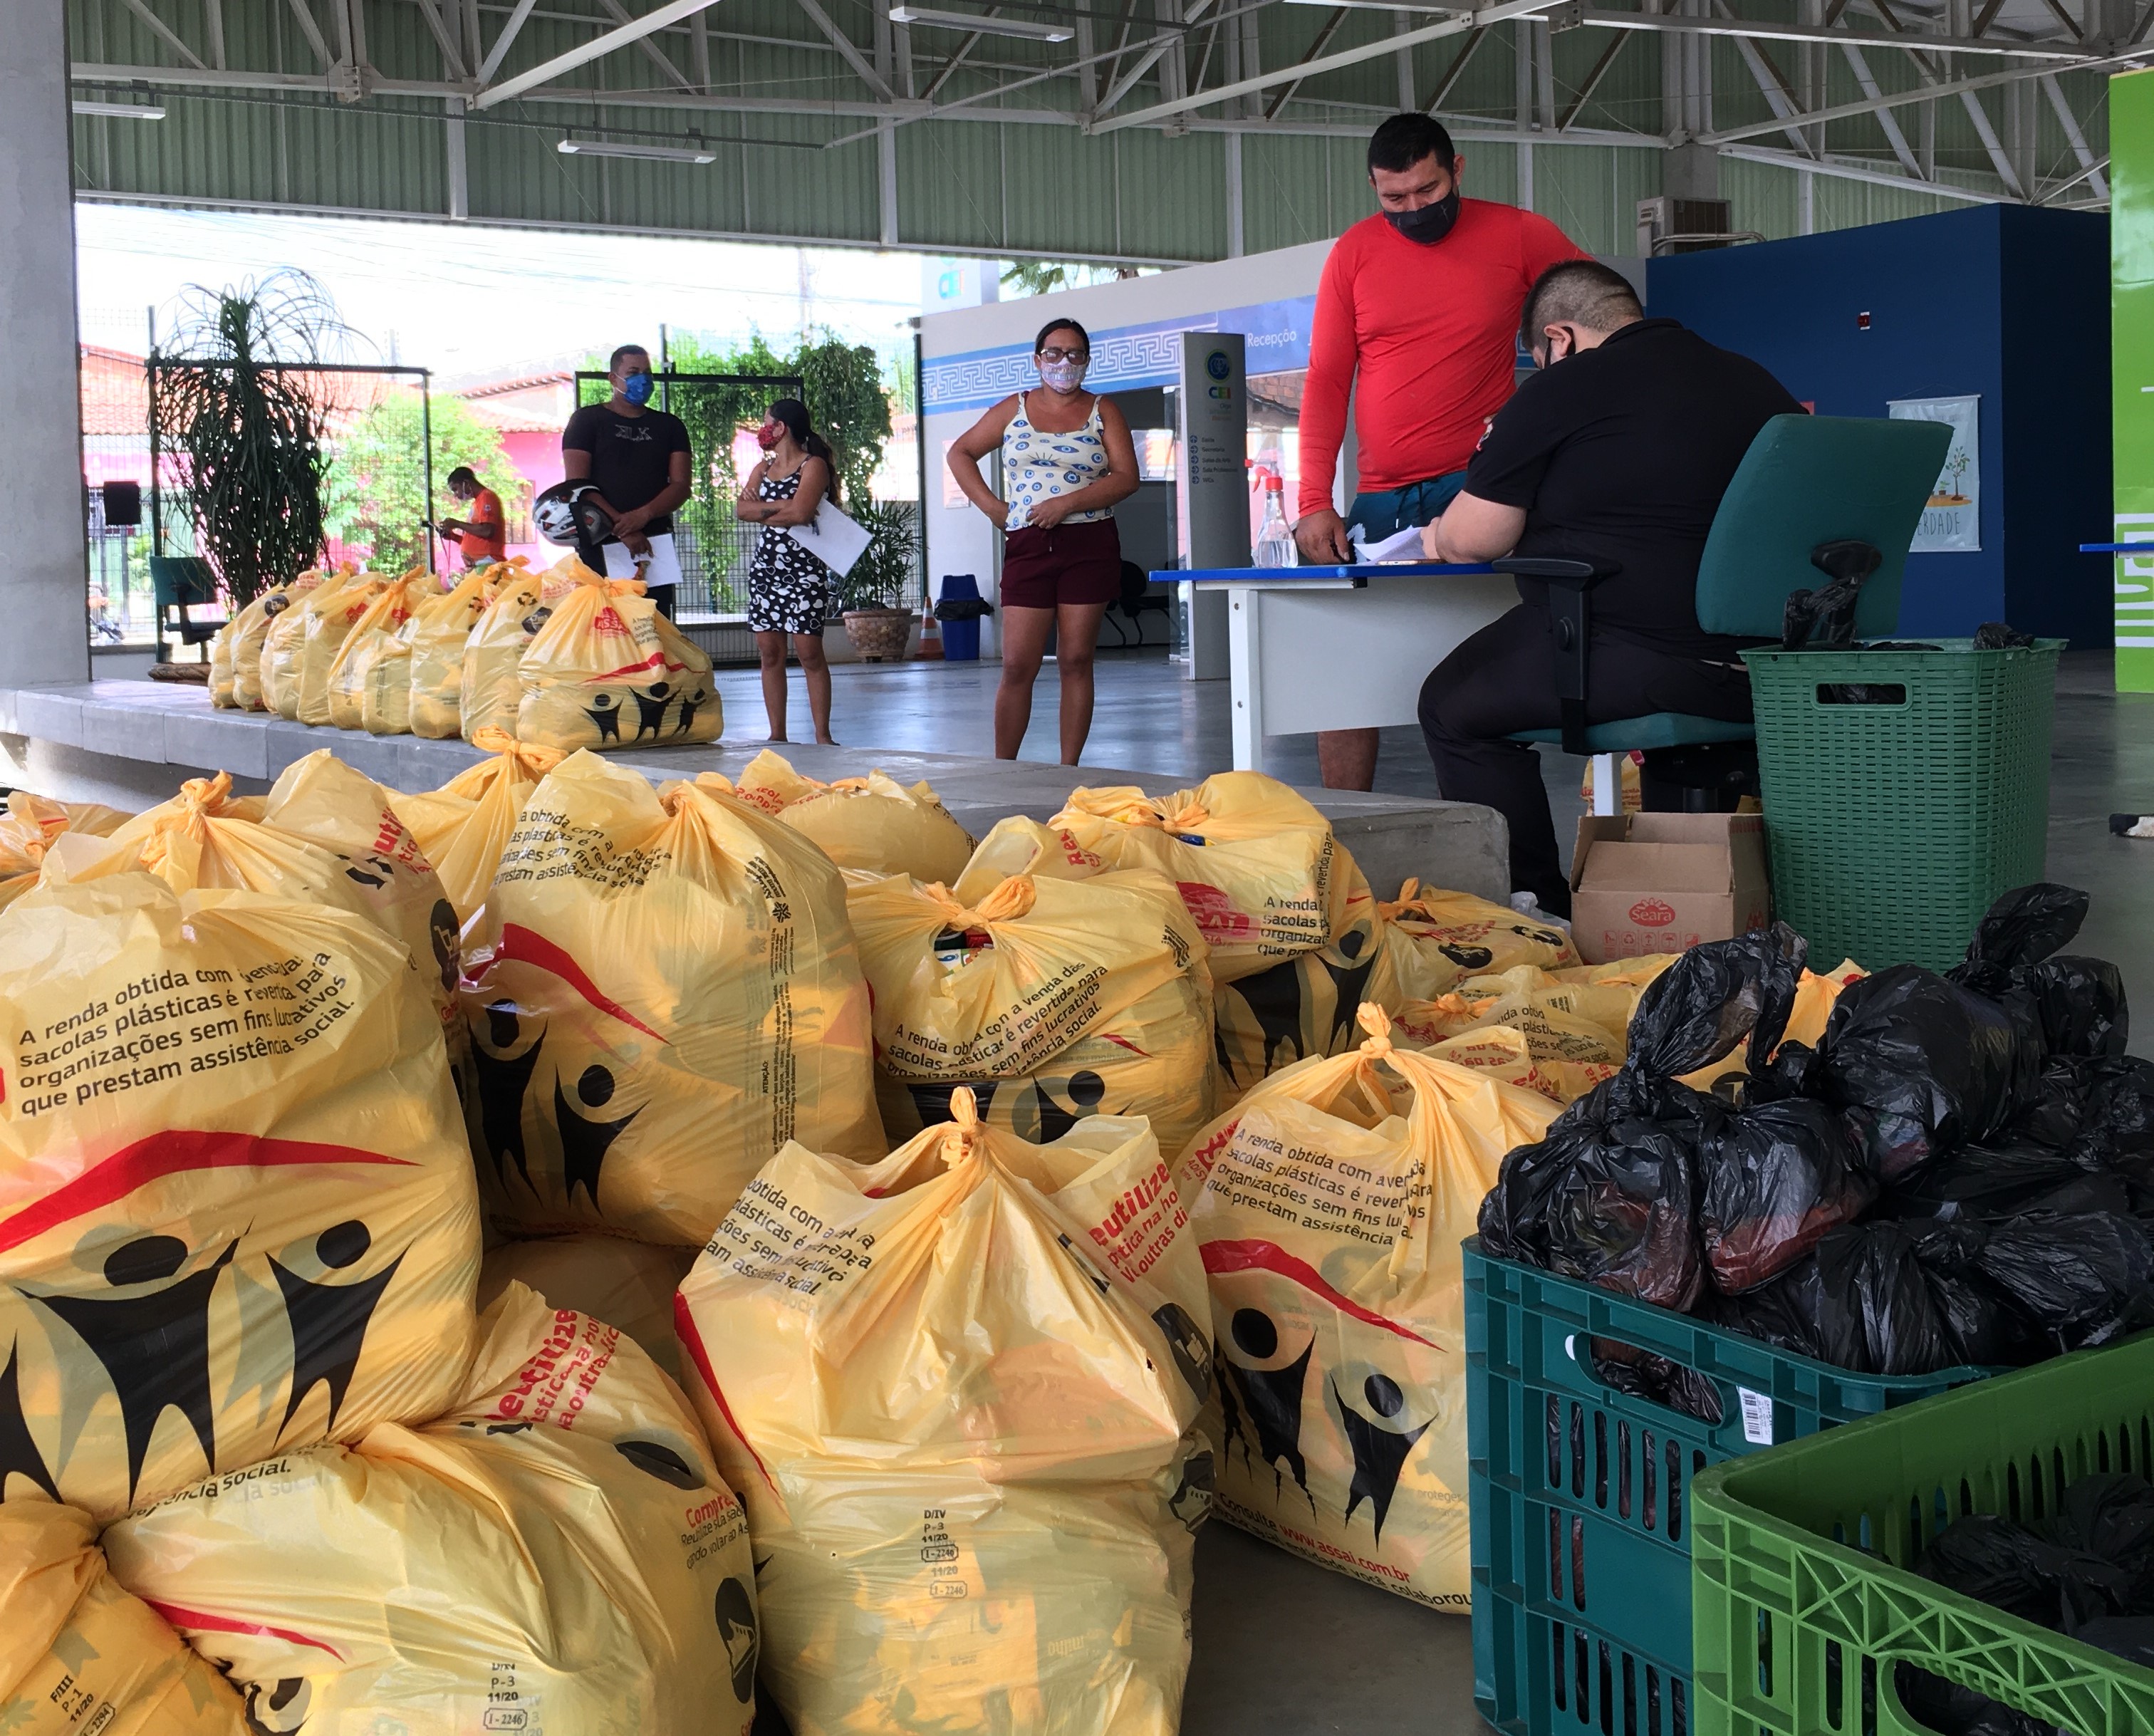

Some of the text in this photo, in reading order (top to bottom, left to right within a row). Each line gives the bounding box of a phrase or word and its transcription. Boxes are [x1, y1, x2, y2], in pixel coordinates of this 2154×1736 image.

[1263, 914, 1316, 928] sacolas
[1631, 910, 1672, 922] Seara
[19, 1030, 36, 1045] A
[46, 1002, 108, 1039] renda
[115, 970, 189, 1006] obtida
[196, 969, 233, 983] com
[20, 1024, 108, 1067] sacolas
[115, 994, 222, 1036] plásticas
[226, 989, 239, 1007] é
[296, 952, 331, 994] para
[895, 1024, 903, 1038] A
[907, 1031, 947, 1054] renda
[1011, 1004, 1023, 1015] a
[1022, 977, 1063, 1007] venda
[1062, 962, 1086, 978] das
[1065, 1000, 1103, 1038] social.
[20, 975, 347, 1088] organizações sem fins lucrativos
[888, 1044, 943, 1070] sacolas
[1005, 1028, 1016, 1042] é
[1017, 987, 1075, 1034] revertida
[992, 1051, 1020, 1075] sem
[1021, 1031, 1044, 1054] fins
[1045, 981, 1101, 1033] lucrativos
[21, 1001, 355, 1117] que prestam assistência social.
[1227, 1148, 1274, 1173] sacolas
[1274, 1165, 1346, 1197] plásticas
[1350, 1185, 1360, 1202] é
[1234, 1128, 1246, 1141] A
[1247, 1134, 1284, 1155] renda
[1287, 1147, 1333, 1170] obtida
[1338, 1163, 1373, 1183] com
[1375, 1175, 1385, 1187] a
[1207, 1179, 1232, 1197] que
[1232, 1192, 1298, 1223] prestam
[1302, 1216, 1393, 1245] assistência
[1217, 1163, 1381, 1226] organizações sem fins
[789, 1205, 823, 1234] com
[750, 1239, 783, 1265] sem
[794, 1235, 808, 1250] é
[1138, 1226, 1175, 1274] outras
[223, 1459, 291, 1491] social.
[924, 1509, 946, 1519] D/IV
[1219, 1492, 1279, 1532] Consulte
[922, 1533, 948, 1543] 11/20
[70, 1693, 94, 1722] 11/20
[487, 1691, 519, 1703] 11/20
[501, 1714, 523, 1725] 2246
